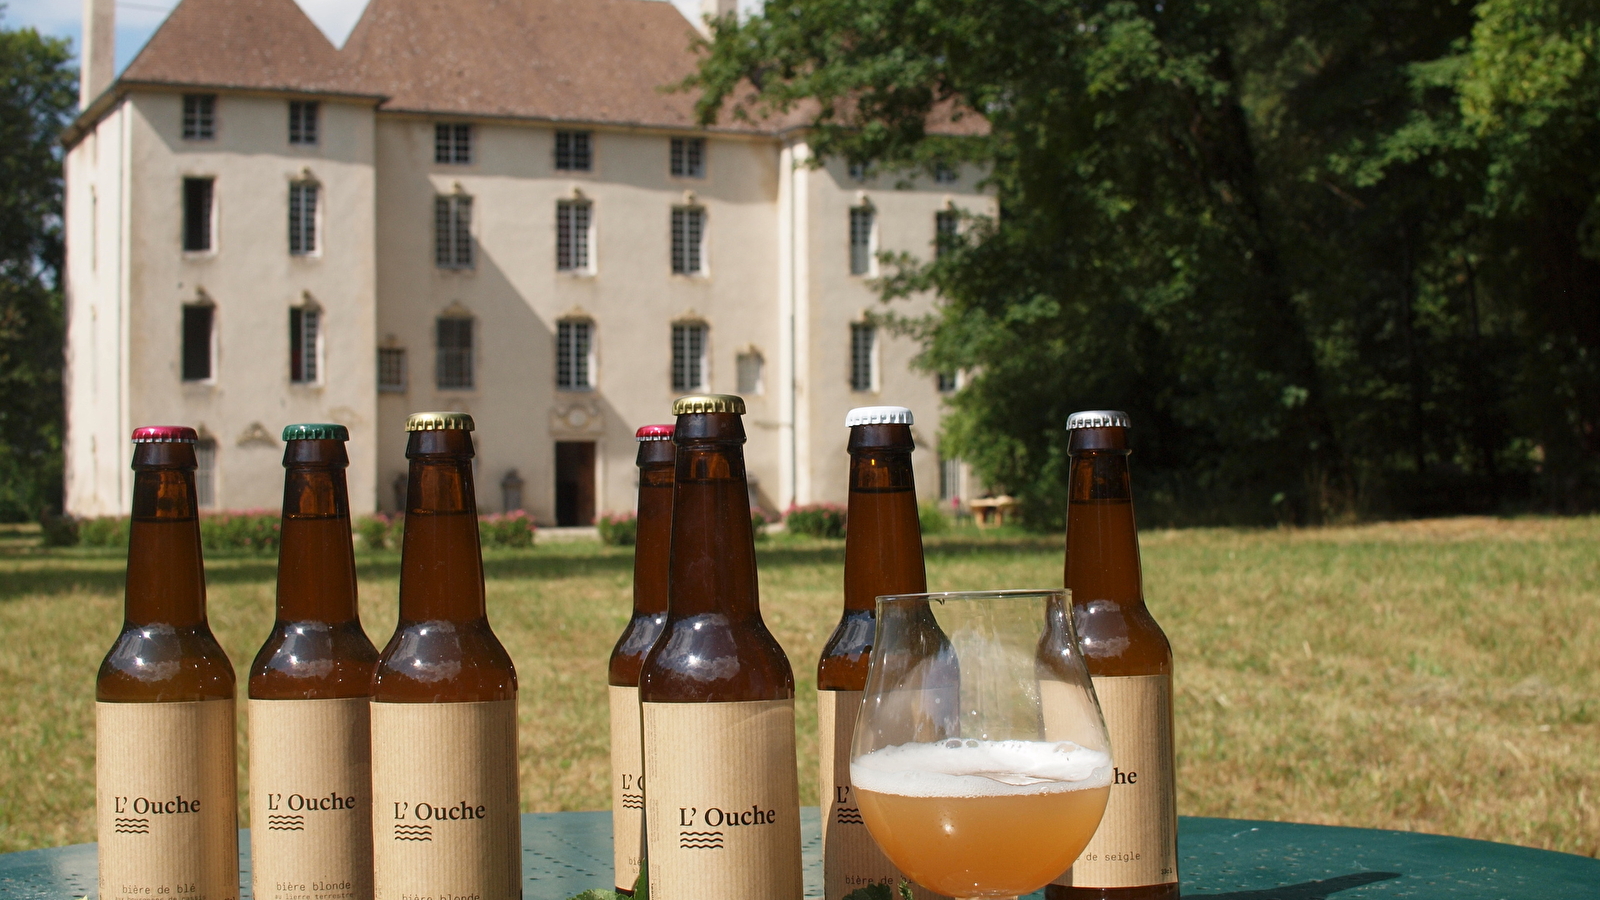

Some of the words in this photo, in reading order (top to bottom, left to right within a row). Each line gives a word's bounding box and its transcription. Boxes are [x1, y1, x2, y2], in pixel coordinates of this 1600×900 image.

[1086, 852, 1098, 861] de
[1104, 851, 1141, 862] seigle
[880, 875, 894, 885] de
[122, 884, 151, 895] bière
[157, 884, 170, 894] de
[176, 882, 196, 894] blé
[276, 881, 306, 892] bière
[312, 880, 351, 891] blonde
